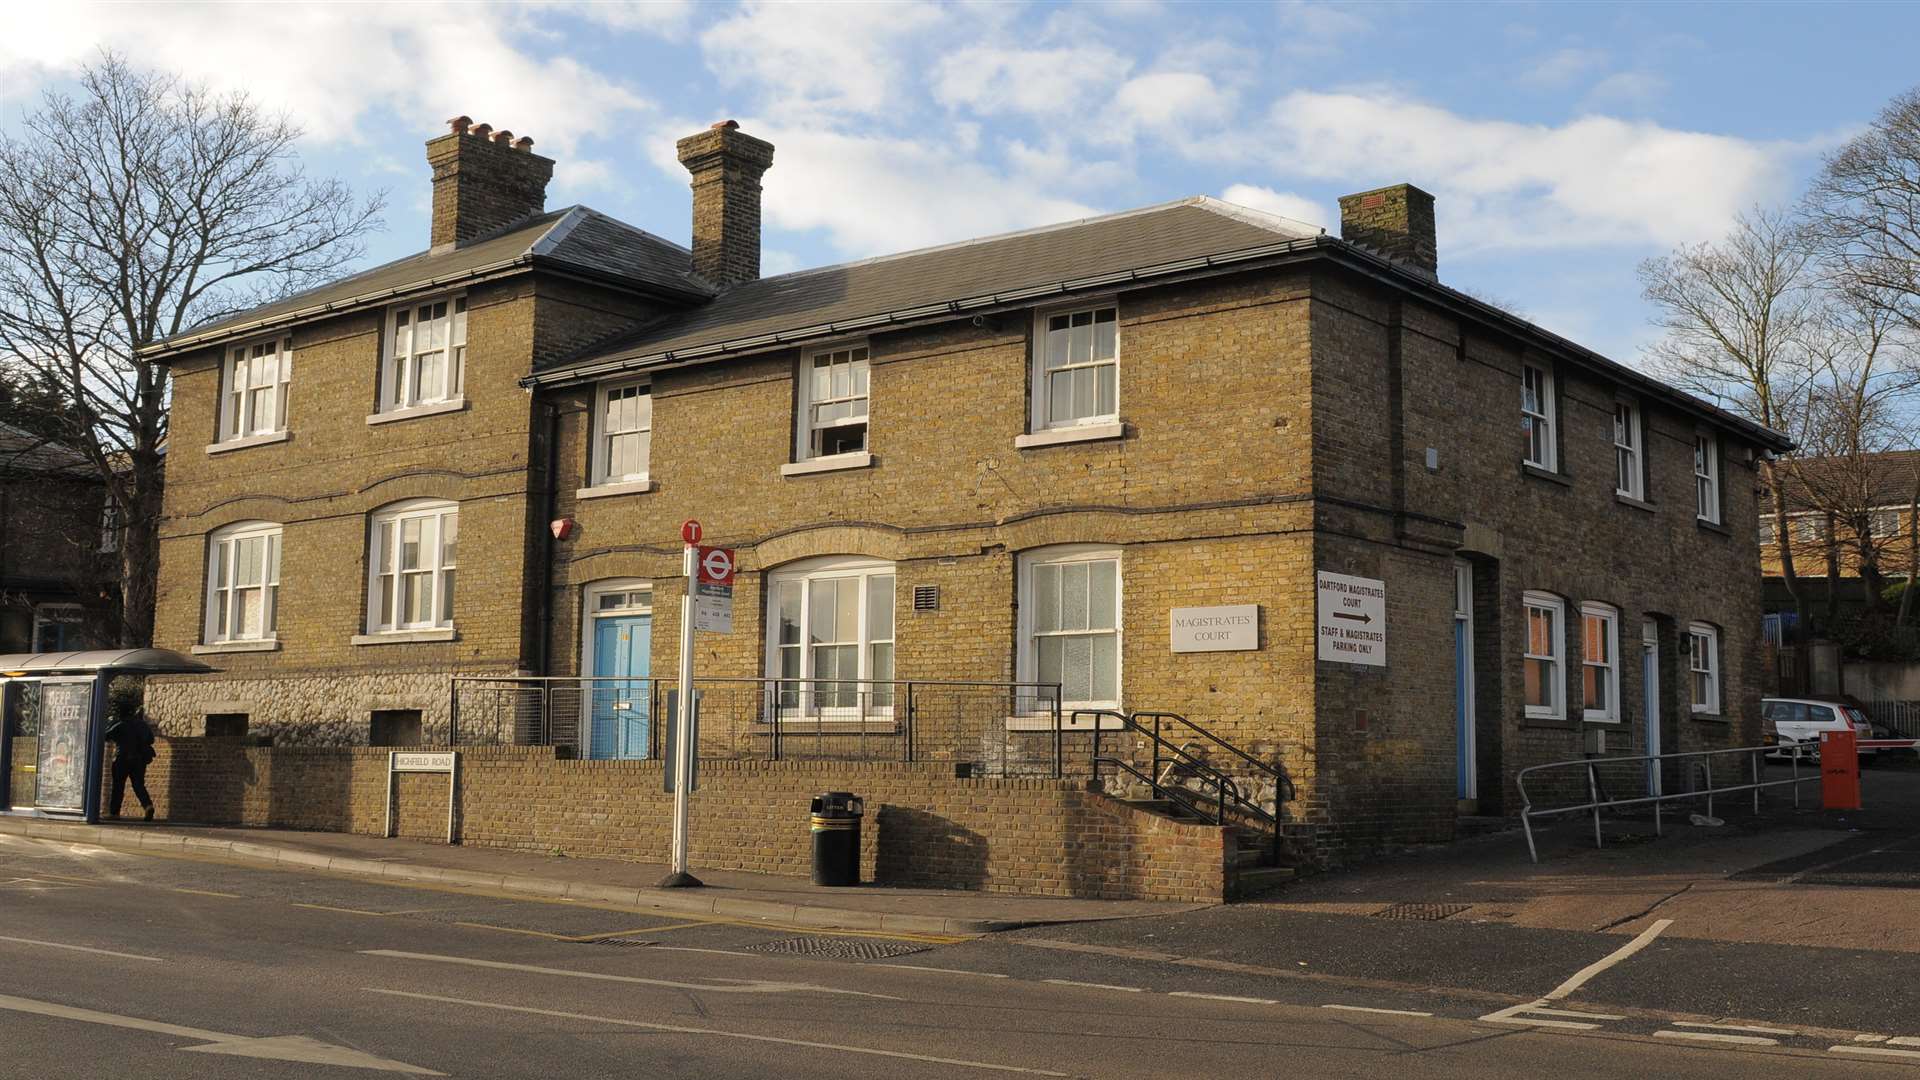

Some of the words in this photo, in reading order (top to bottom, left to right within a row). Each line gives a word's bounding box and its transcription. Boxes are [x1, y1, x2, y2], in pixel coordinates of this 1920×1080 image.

[687, 523, 699, 540] T
[1320, 580, 1347, 593] DARTFORD
[1349, 585, 1384, 599] MAGISTRATES
[1343, 597, 1361, 608] COURT
[1194, 631, 1232, 641] COURT
[1321, 626, 1338, 638] STAFF
[1340, 629, 1344, 638] &
[1346, 629, 1384, 642] MAGISTRATES
[1333, 641, 1357, 653] PARKING
[1359, 644, 1372, 655] ONLY
[48, 690, 72, 705] DEEP
[51, 705, 80, 720] FREEZE
[398, 757, 429, 767] HIGHFIELD
[431, 757, 451, 767] ROAD
